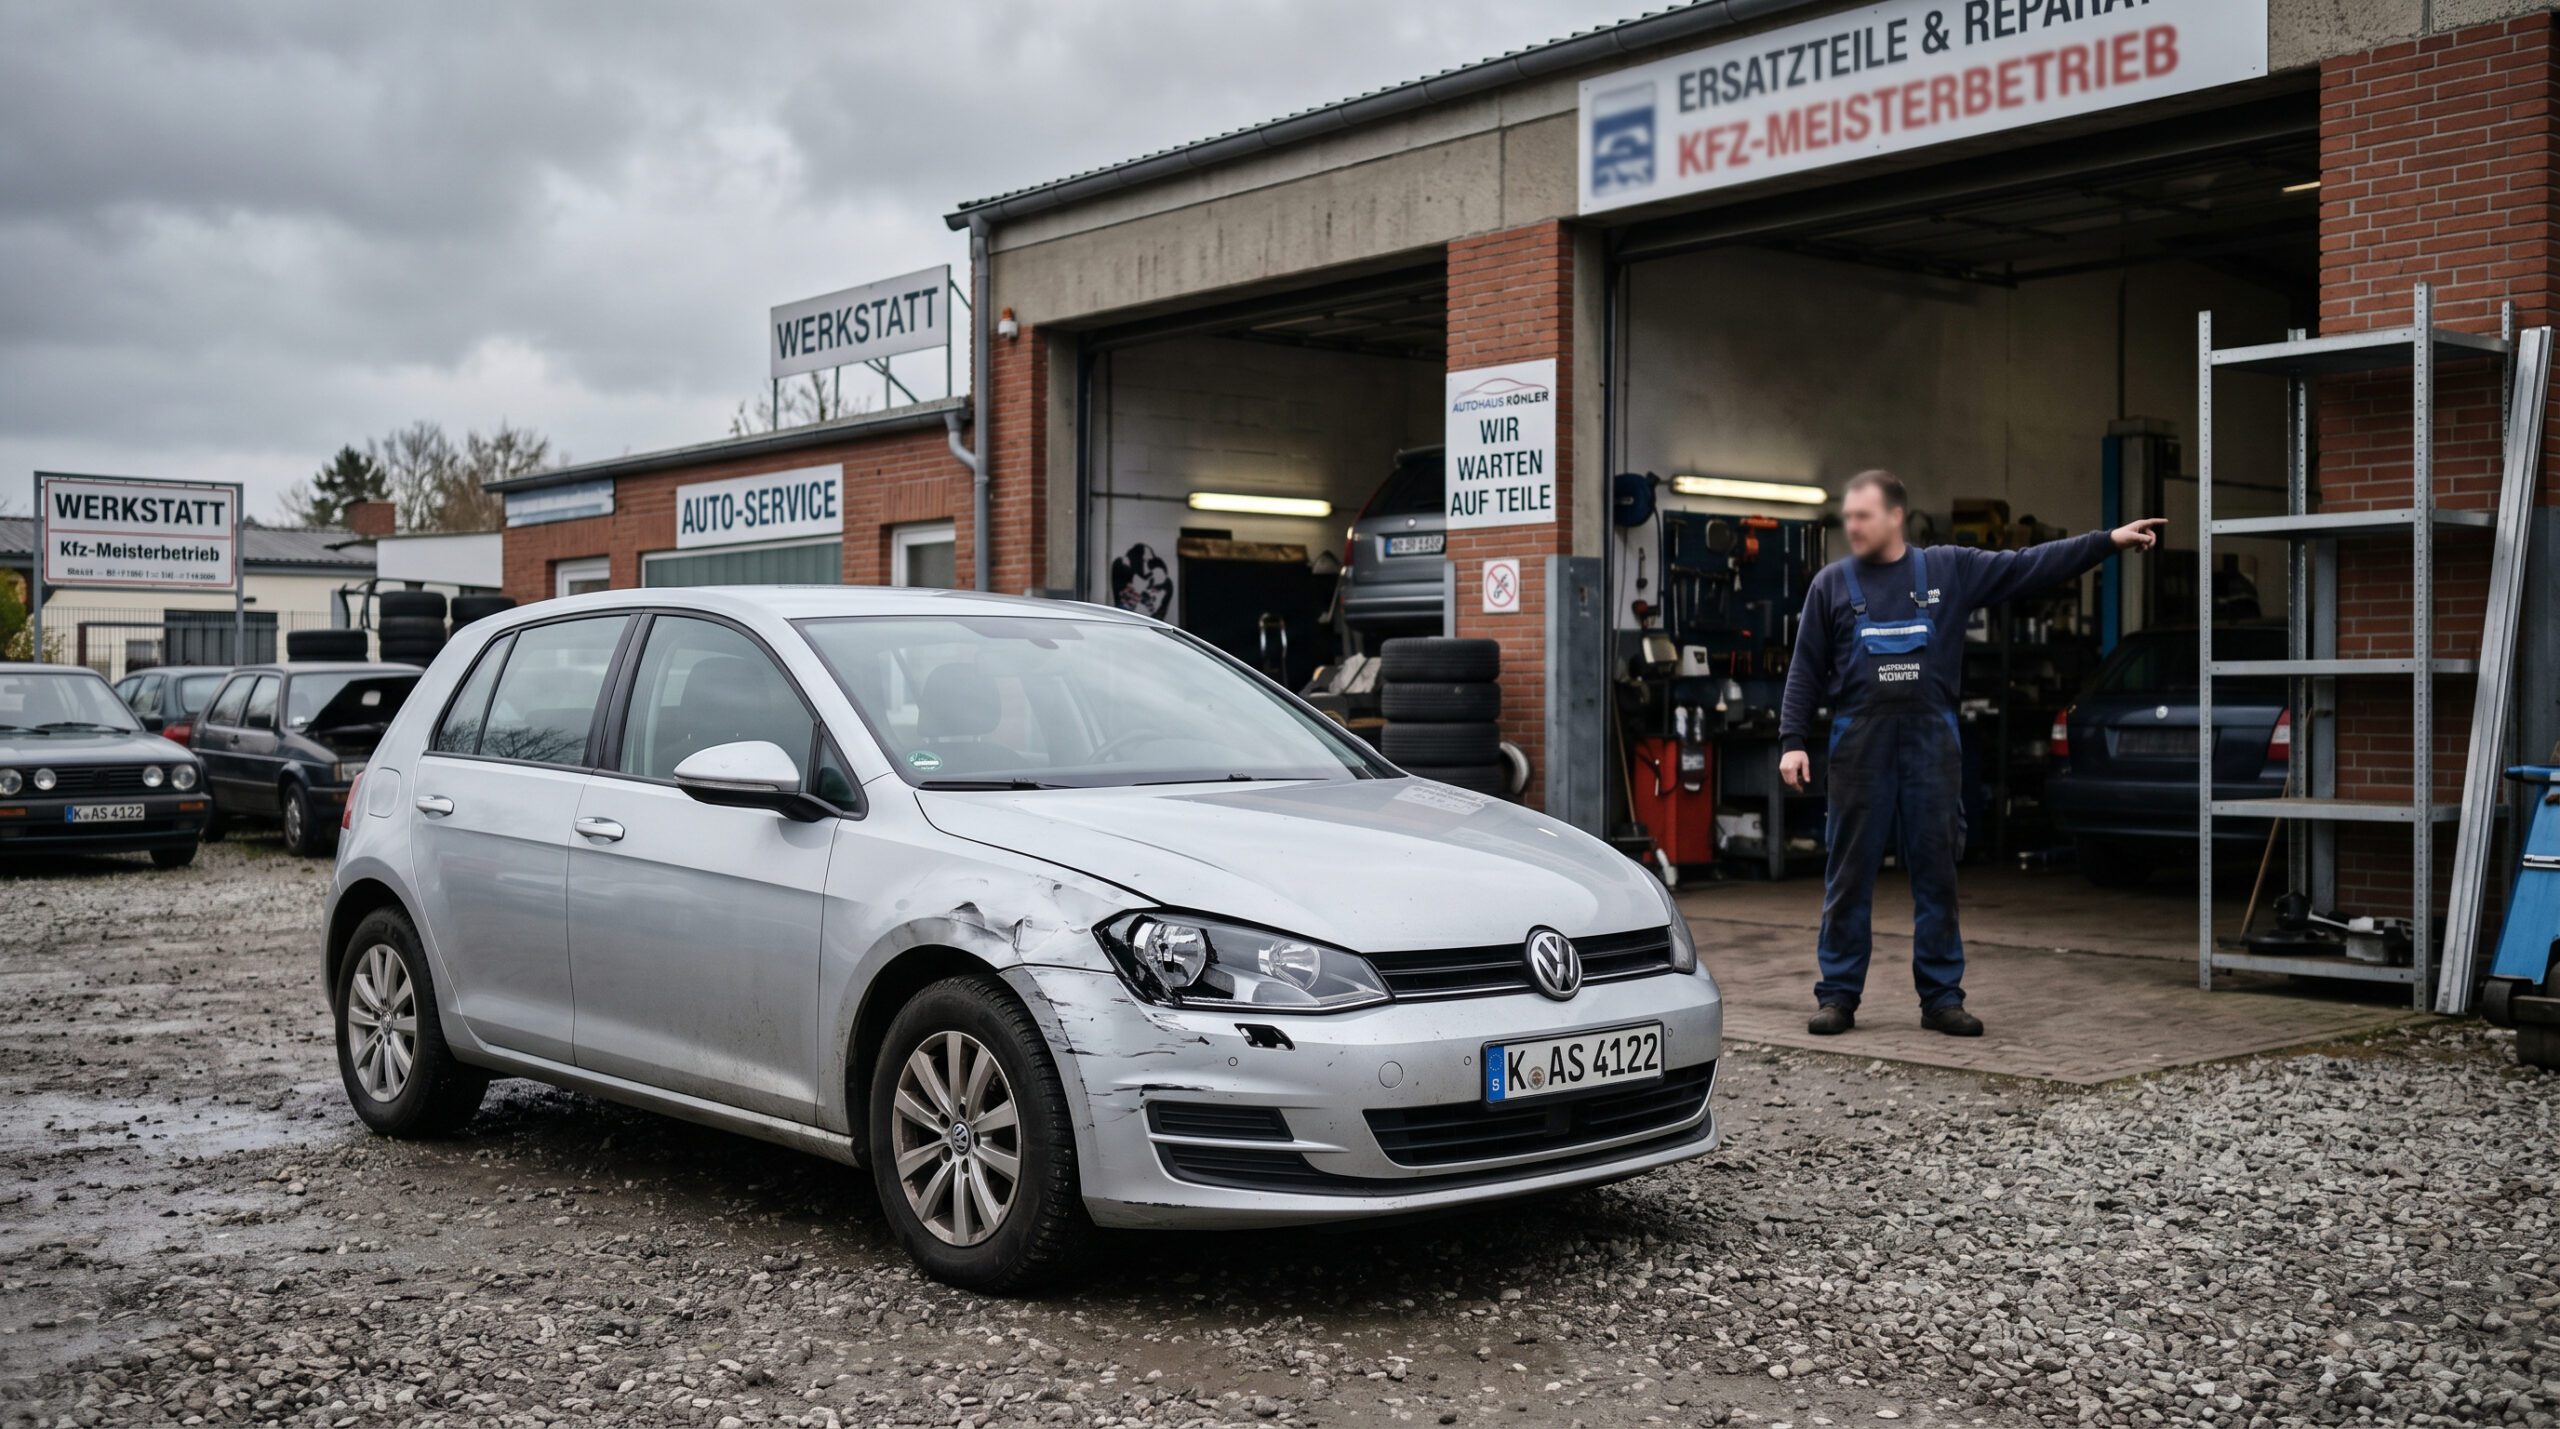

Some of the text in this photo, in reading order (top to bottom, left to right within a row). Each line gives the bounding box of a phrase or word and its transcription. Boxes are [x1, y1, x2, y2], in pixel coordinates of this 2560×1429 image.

[1679, 0, 2151, 114] ERSATZTEILE & REPA
[1678, 23, 2179, 178] KFZ-MEISTERBETRIEB
[777, 286, 939, 360] WERKSTATT
[1452, 397, 1505, 413] AUTOHAUS
[1480, 416, 1519, 445] WIR
[1457, 449, 1543, 481] WARTEN
[55, 492, 226, 527] WERKSTATT
[682, 480, 837, 535] AUTO-SERVICE
[1450, 484, 1551, 517] AUF TEILE
[60, 540, 220, 563] Kfz-Meisterbetrieb
[73, 806, 143, 820] K AS 4122
[1508, 1050, 1527, 1092] K
[1548, 1043, 1585, 1086] AS
[1593, 1032, 1659, 1079] 4122
